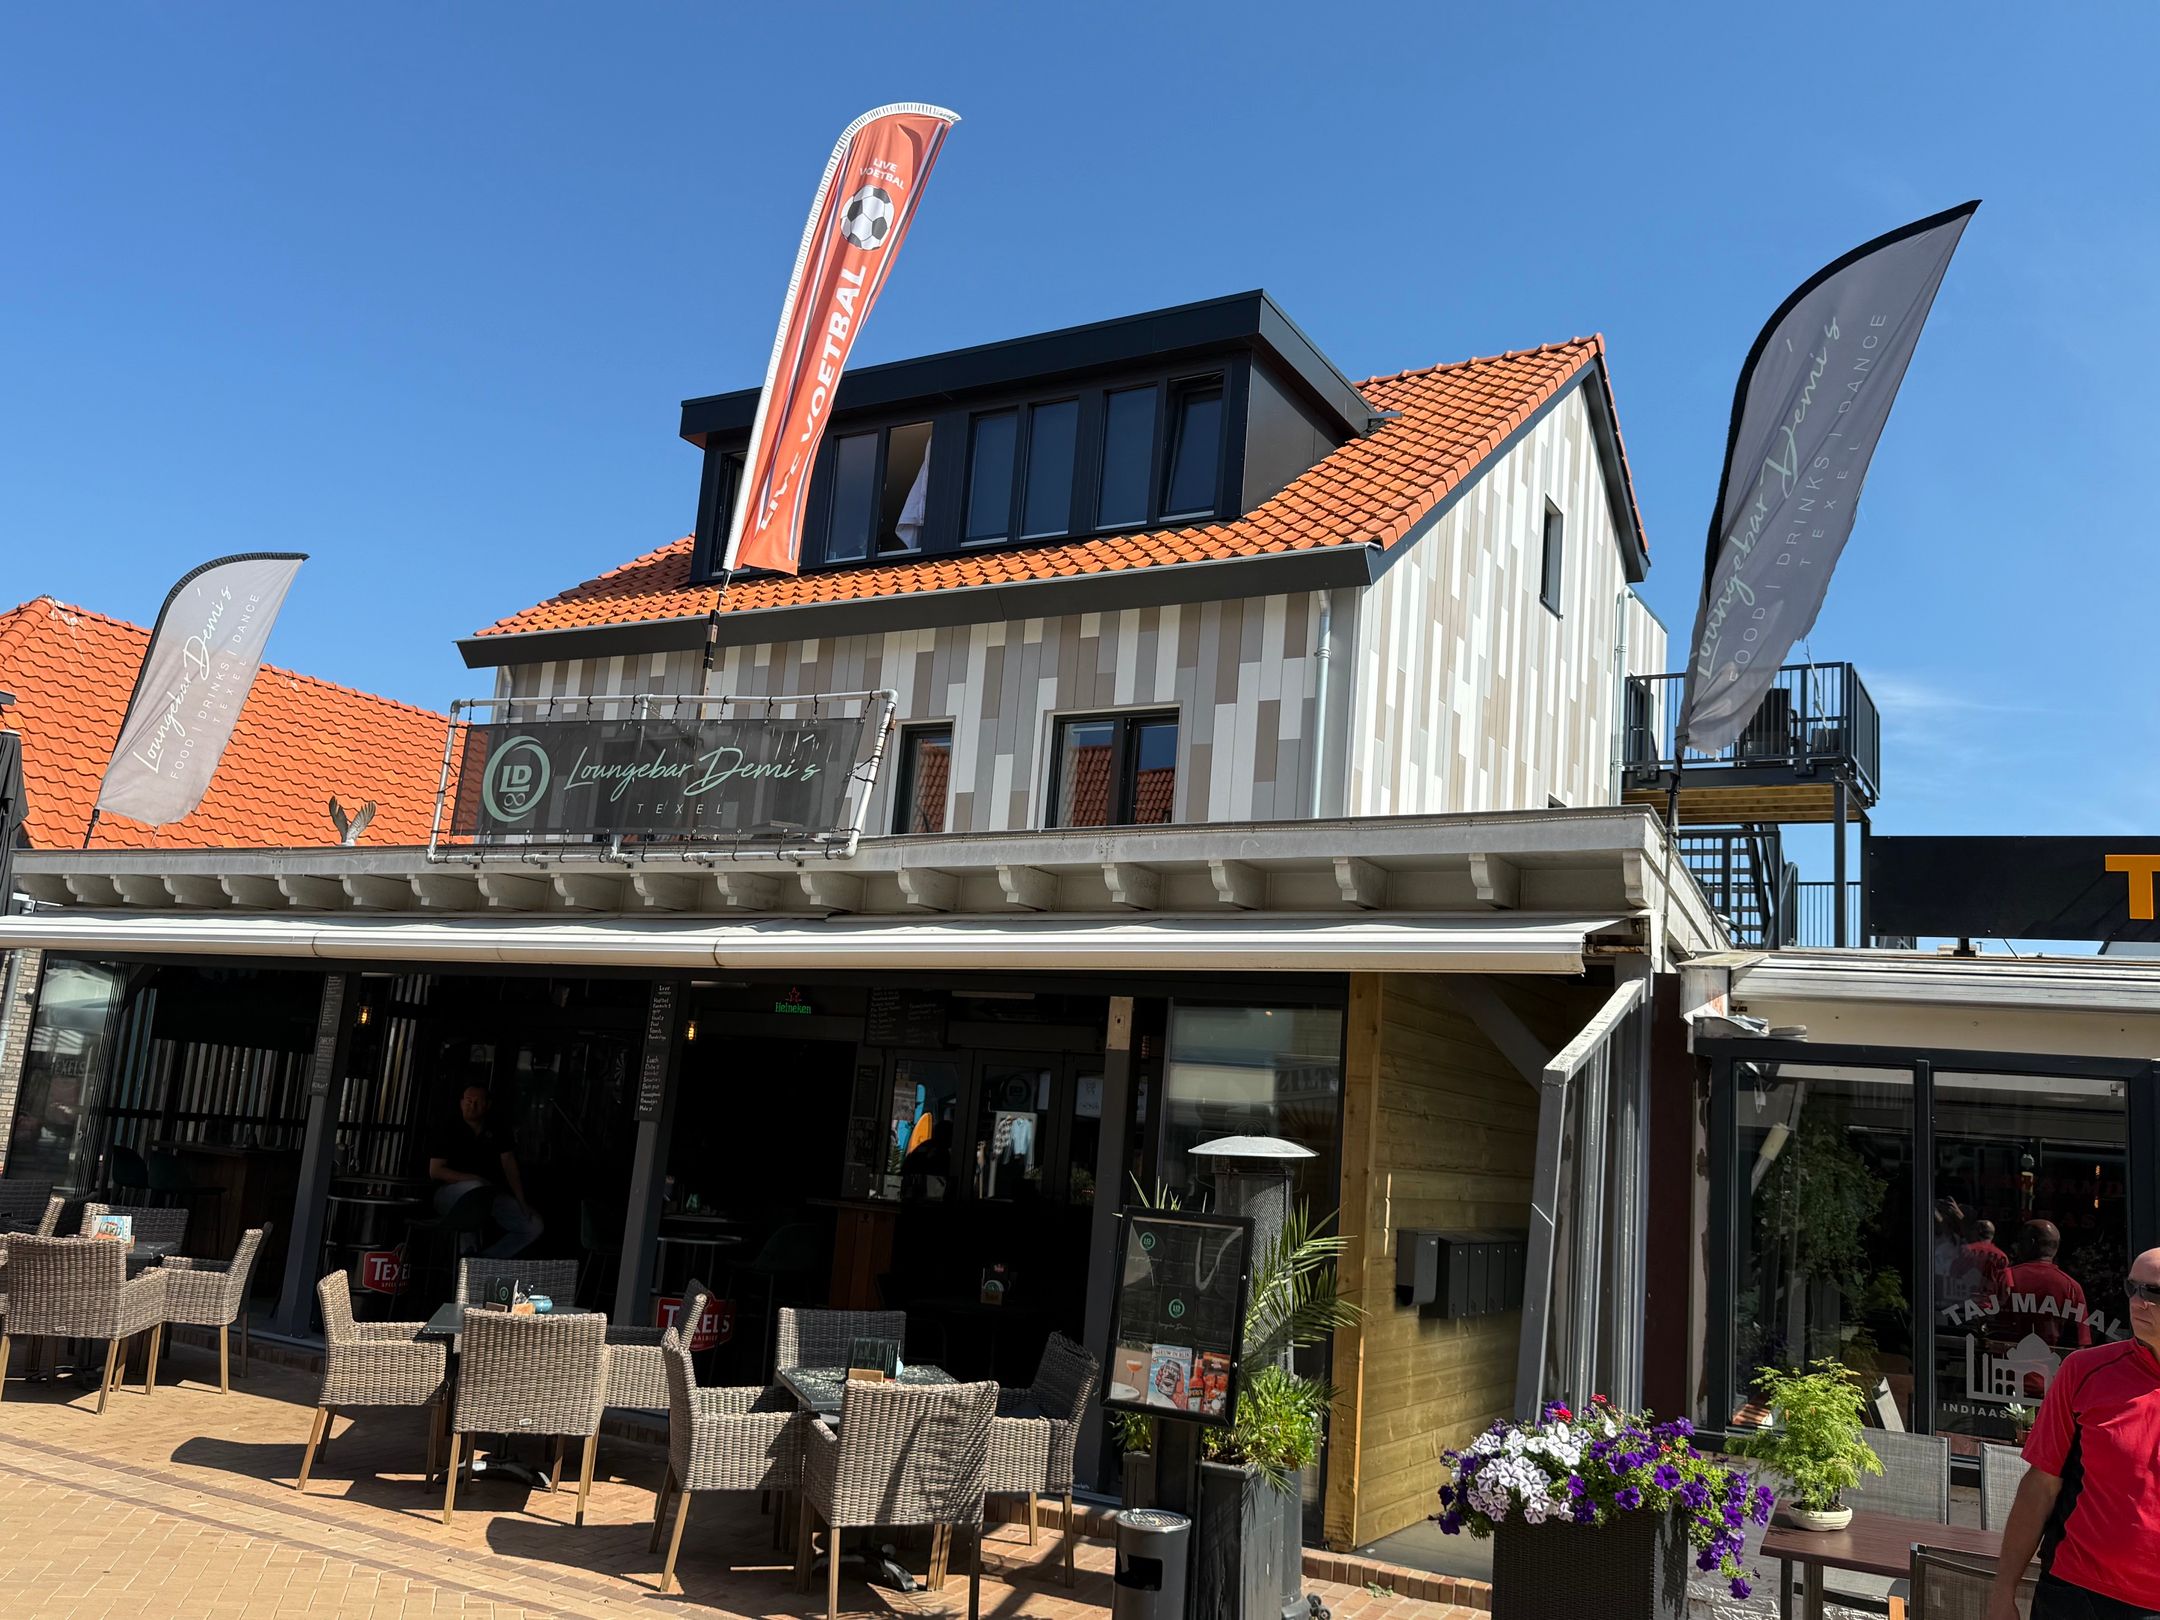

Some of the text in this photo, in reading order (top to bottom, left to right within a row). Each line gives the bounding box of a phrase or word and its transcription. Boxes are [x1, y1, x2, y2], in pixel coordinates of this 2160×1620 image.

[859, 167, 904, 190] VOETBAL
[873, 158, 897, 172] LIVE
[800, 265, 867, 443] VOETBAL
[1697, 316, 1840, 679] Loungebar Demi's
[1728, 314, 1886, 682] FOOD DRINKS DANCE
[1799, 441, 1861, 567] TEXEL
[133, 585, 232, 774] Loungebar Demi's
[170, 594, 260, 780] FOOD DRINKS DANCE
[212, 660, 247, 723] TEXEL
[563, 734, 821, 802] Loungebar Demi's
[637, 803, 723, 815] TEXEL
[774, 1001, 812, 1015] Heineken
[662, 1305, 730, 1333] TELS
[1941, 1293, 2127, 1341] TAJ MAHAL
[1943, 1402, 2008, 1419] INDIAAS
